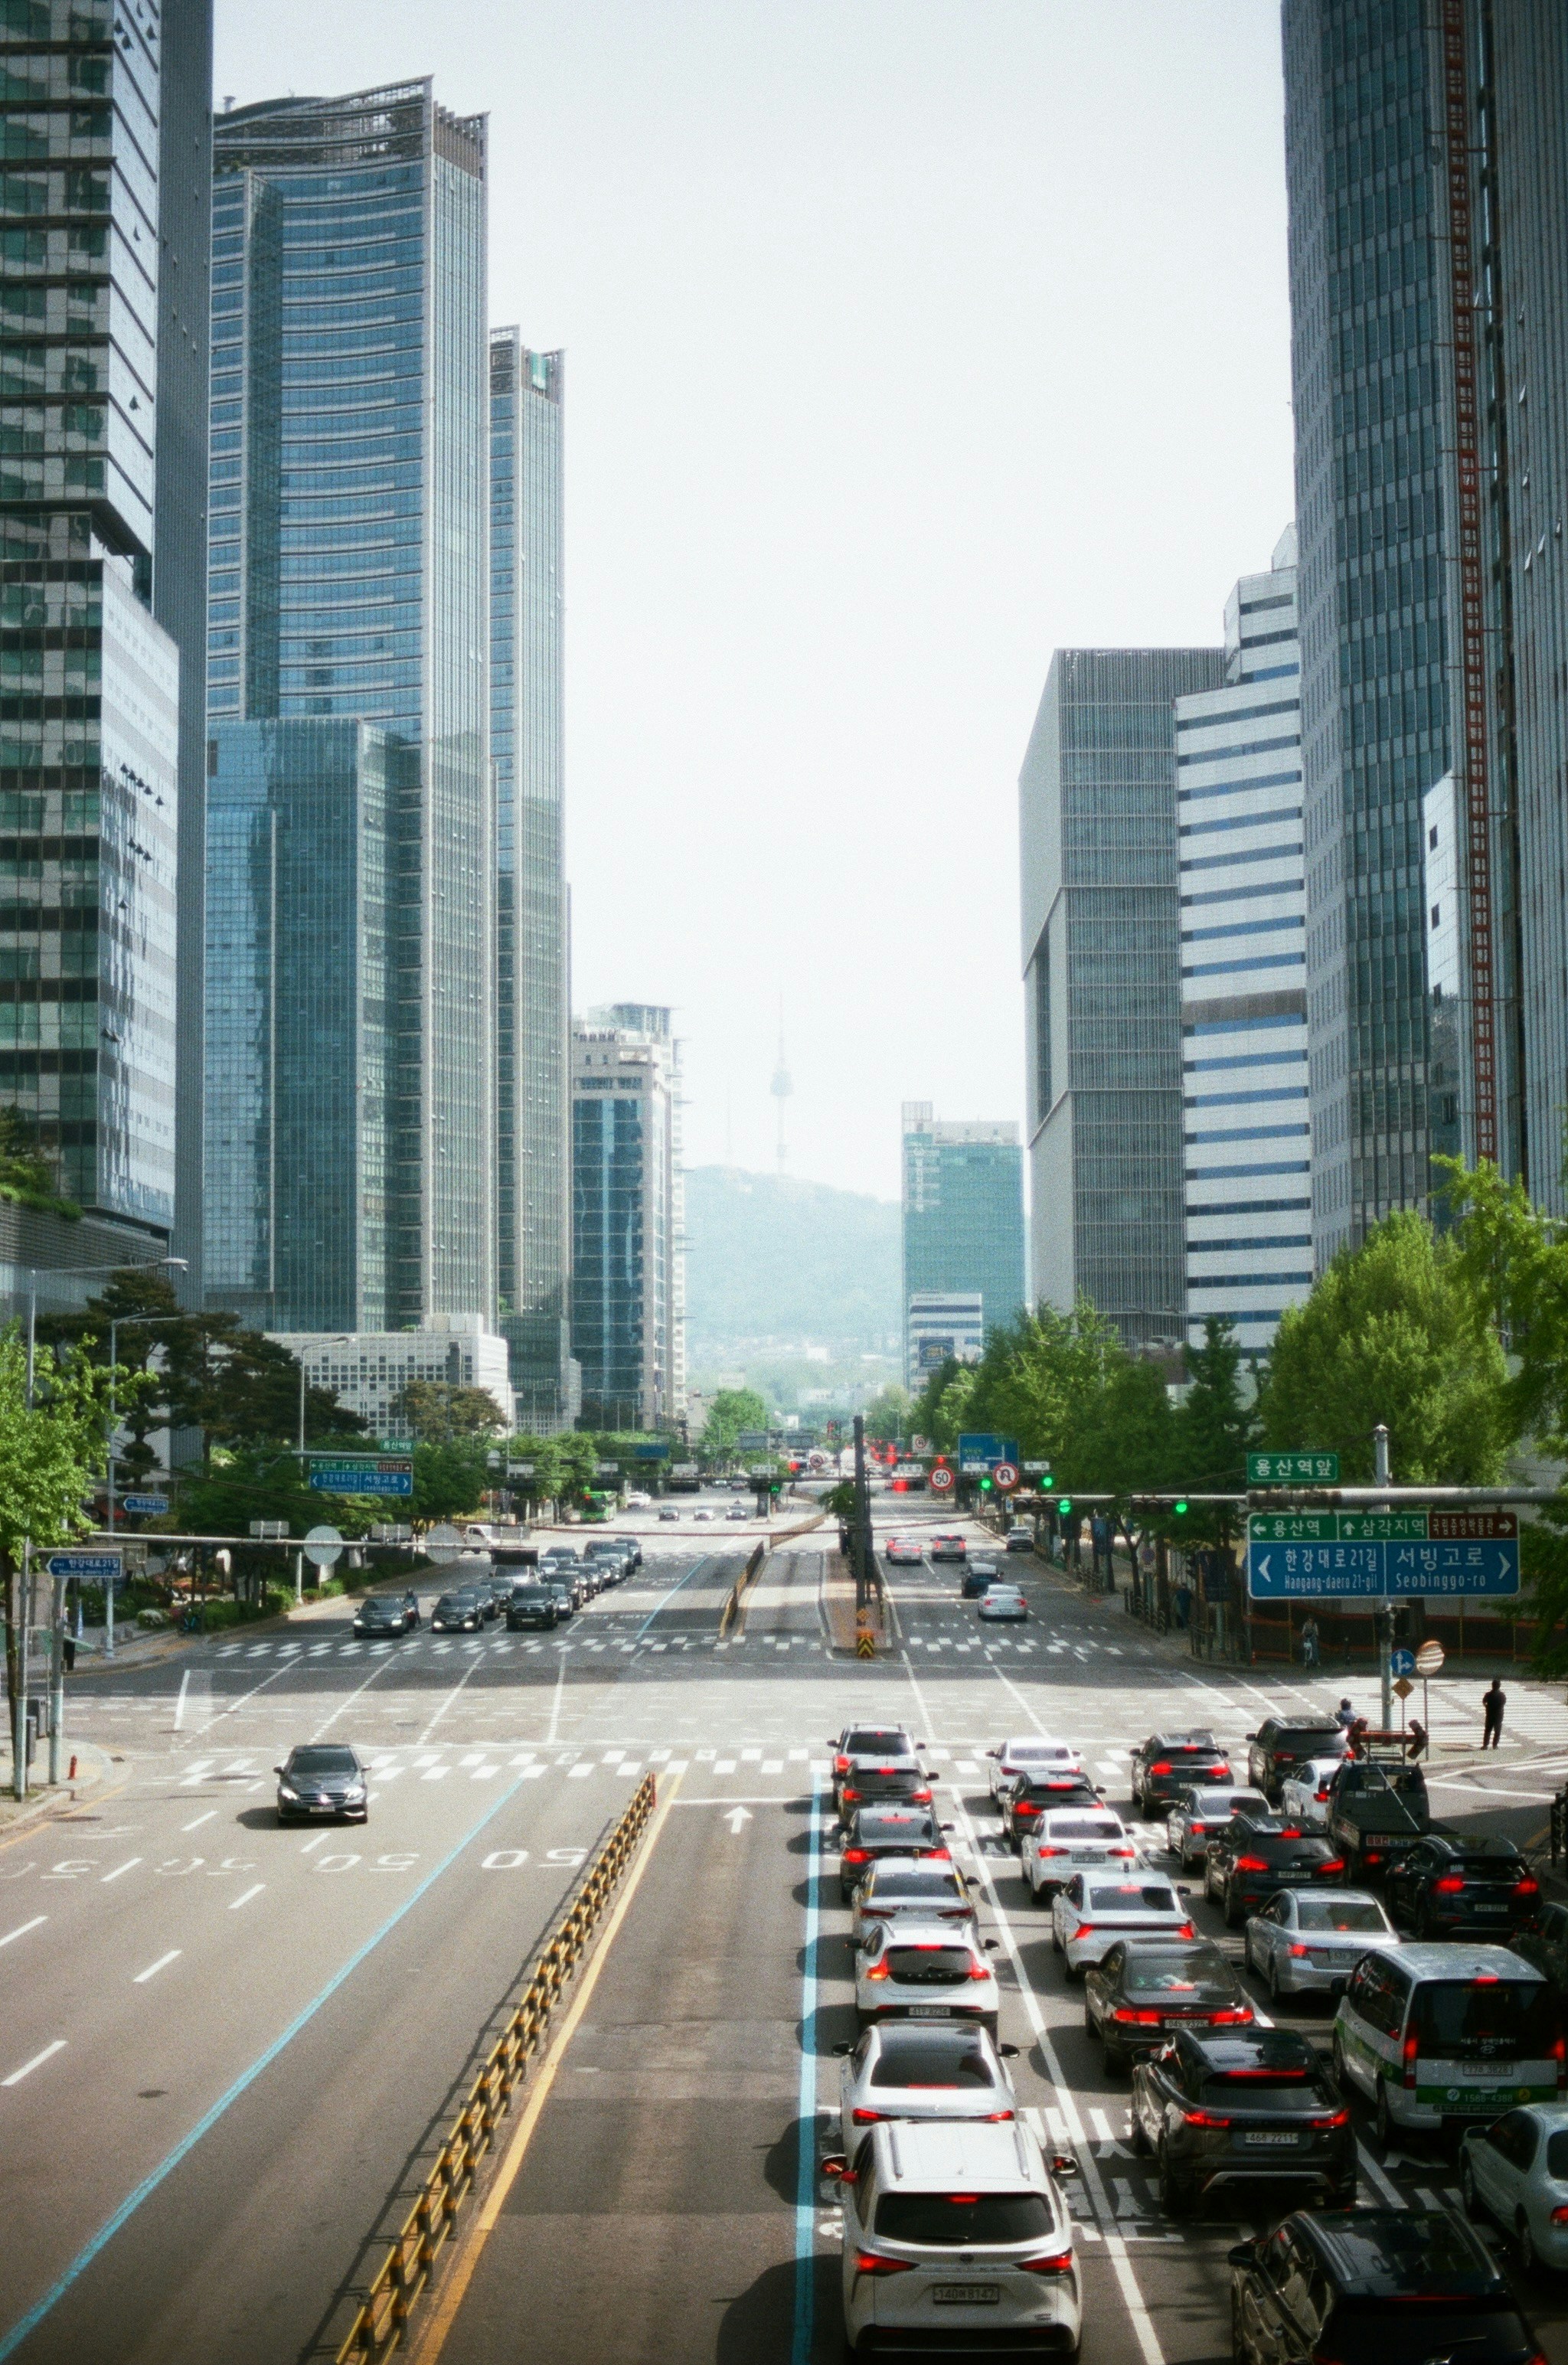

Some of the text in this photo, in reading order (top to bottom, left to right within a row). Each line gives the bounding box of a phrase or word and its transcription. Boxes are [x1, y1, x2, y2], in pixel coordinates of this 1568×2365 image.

[1255, 1459, 1331, 1477] 용산역앞
[936, 1472, 949, 1484] 50
[1272, 1520, 1320, 1537] 용산역
[1361, 1519, 1425, 1537] 삼각지역
[1433, 1518, 1494, 1536] 국립중앙박물관
[1285, 1548, 1377, 1572] 한강대로21길
[1396, 1547, 1485, 1571] 서빙고로
[1285, 1574, 1377, 1592] Hangang-daero 21-gil
[1396, 1573, 1486, 1590] Seobinggo-ro
